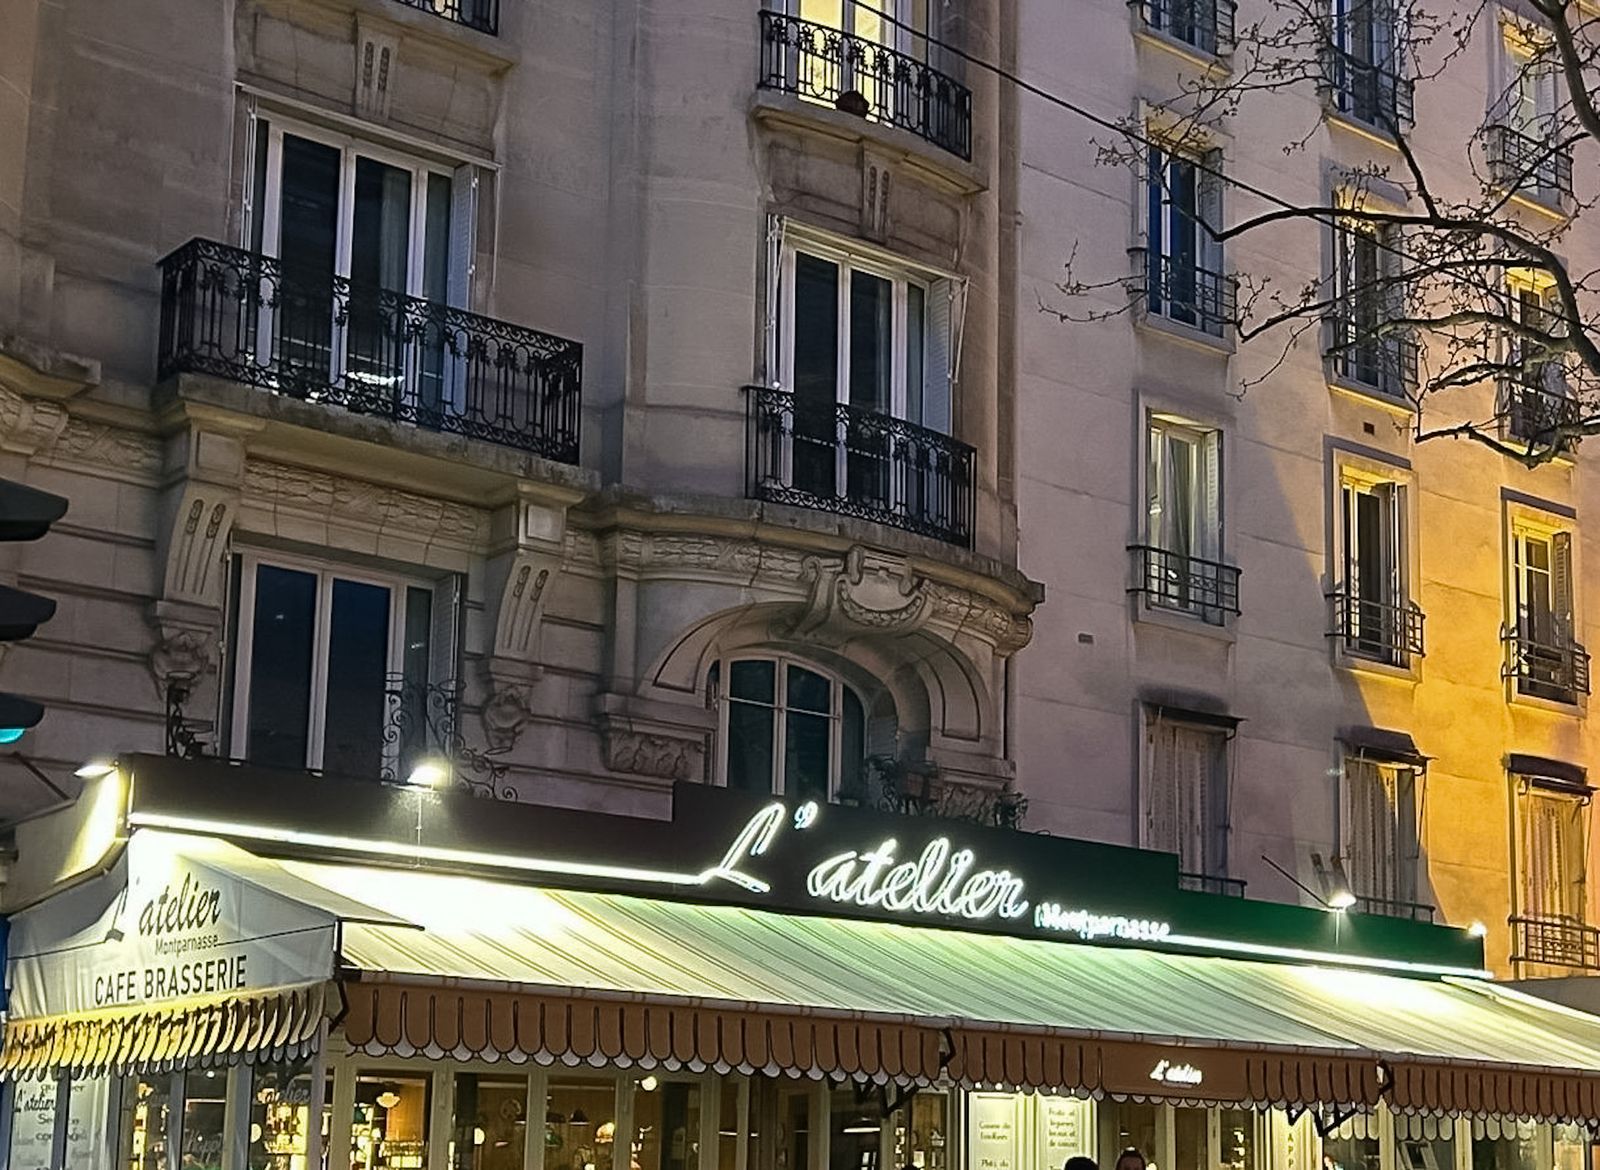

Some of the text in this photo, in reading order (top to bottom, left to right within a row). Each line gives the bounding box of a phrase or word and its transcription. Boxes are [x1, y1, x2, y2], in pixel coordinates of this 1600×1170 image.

[1034, 902, 1170, 941] Montparnasse
[155, 934, 218, 957] Montparnasse
[95, 954, 247, 1005] CAFE BRASSERIE
